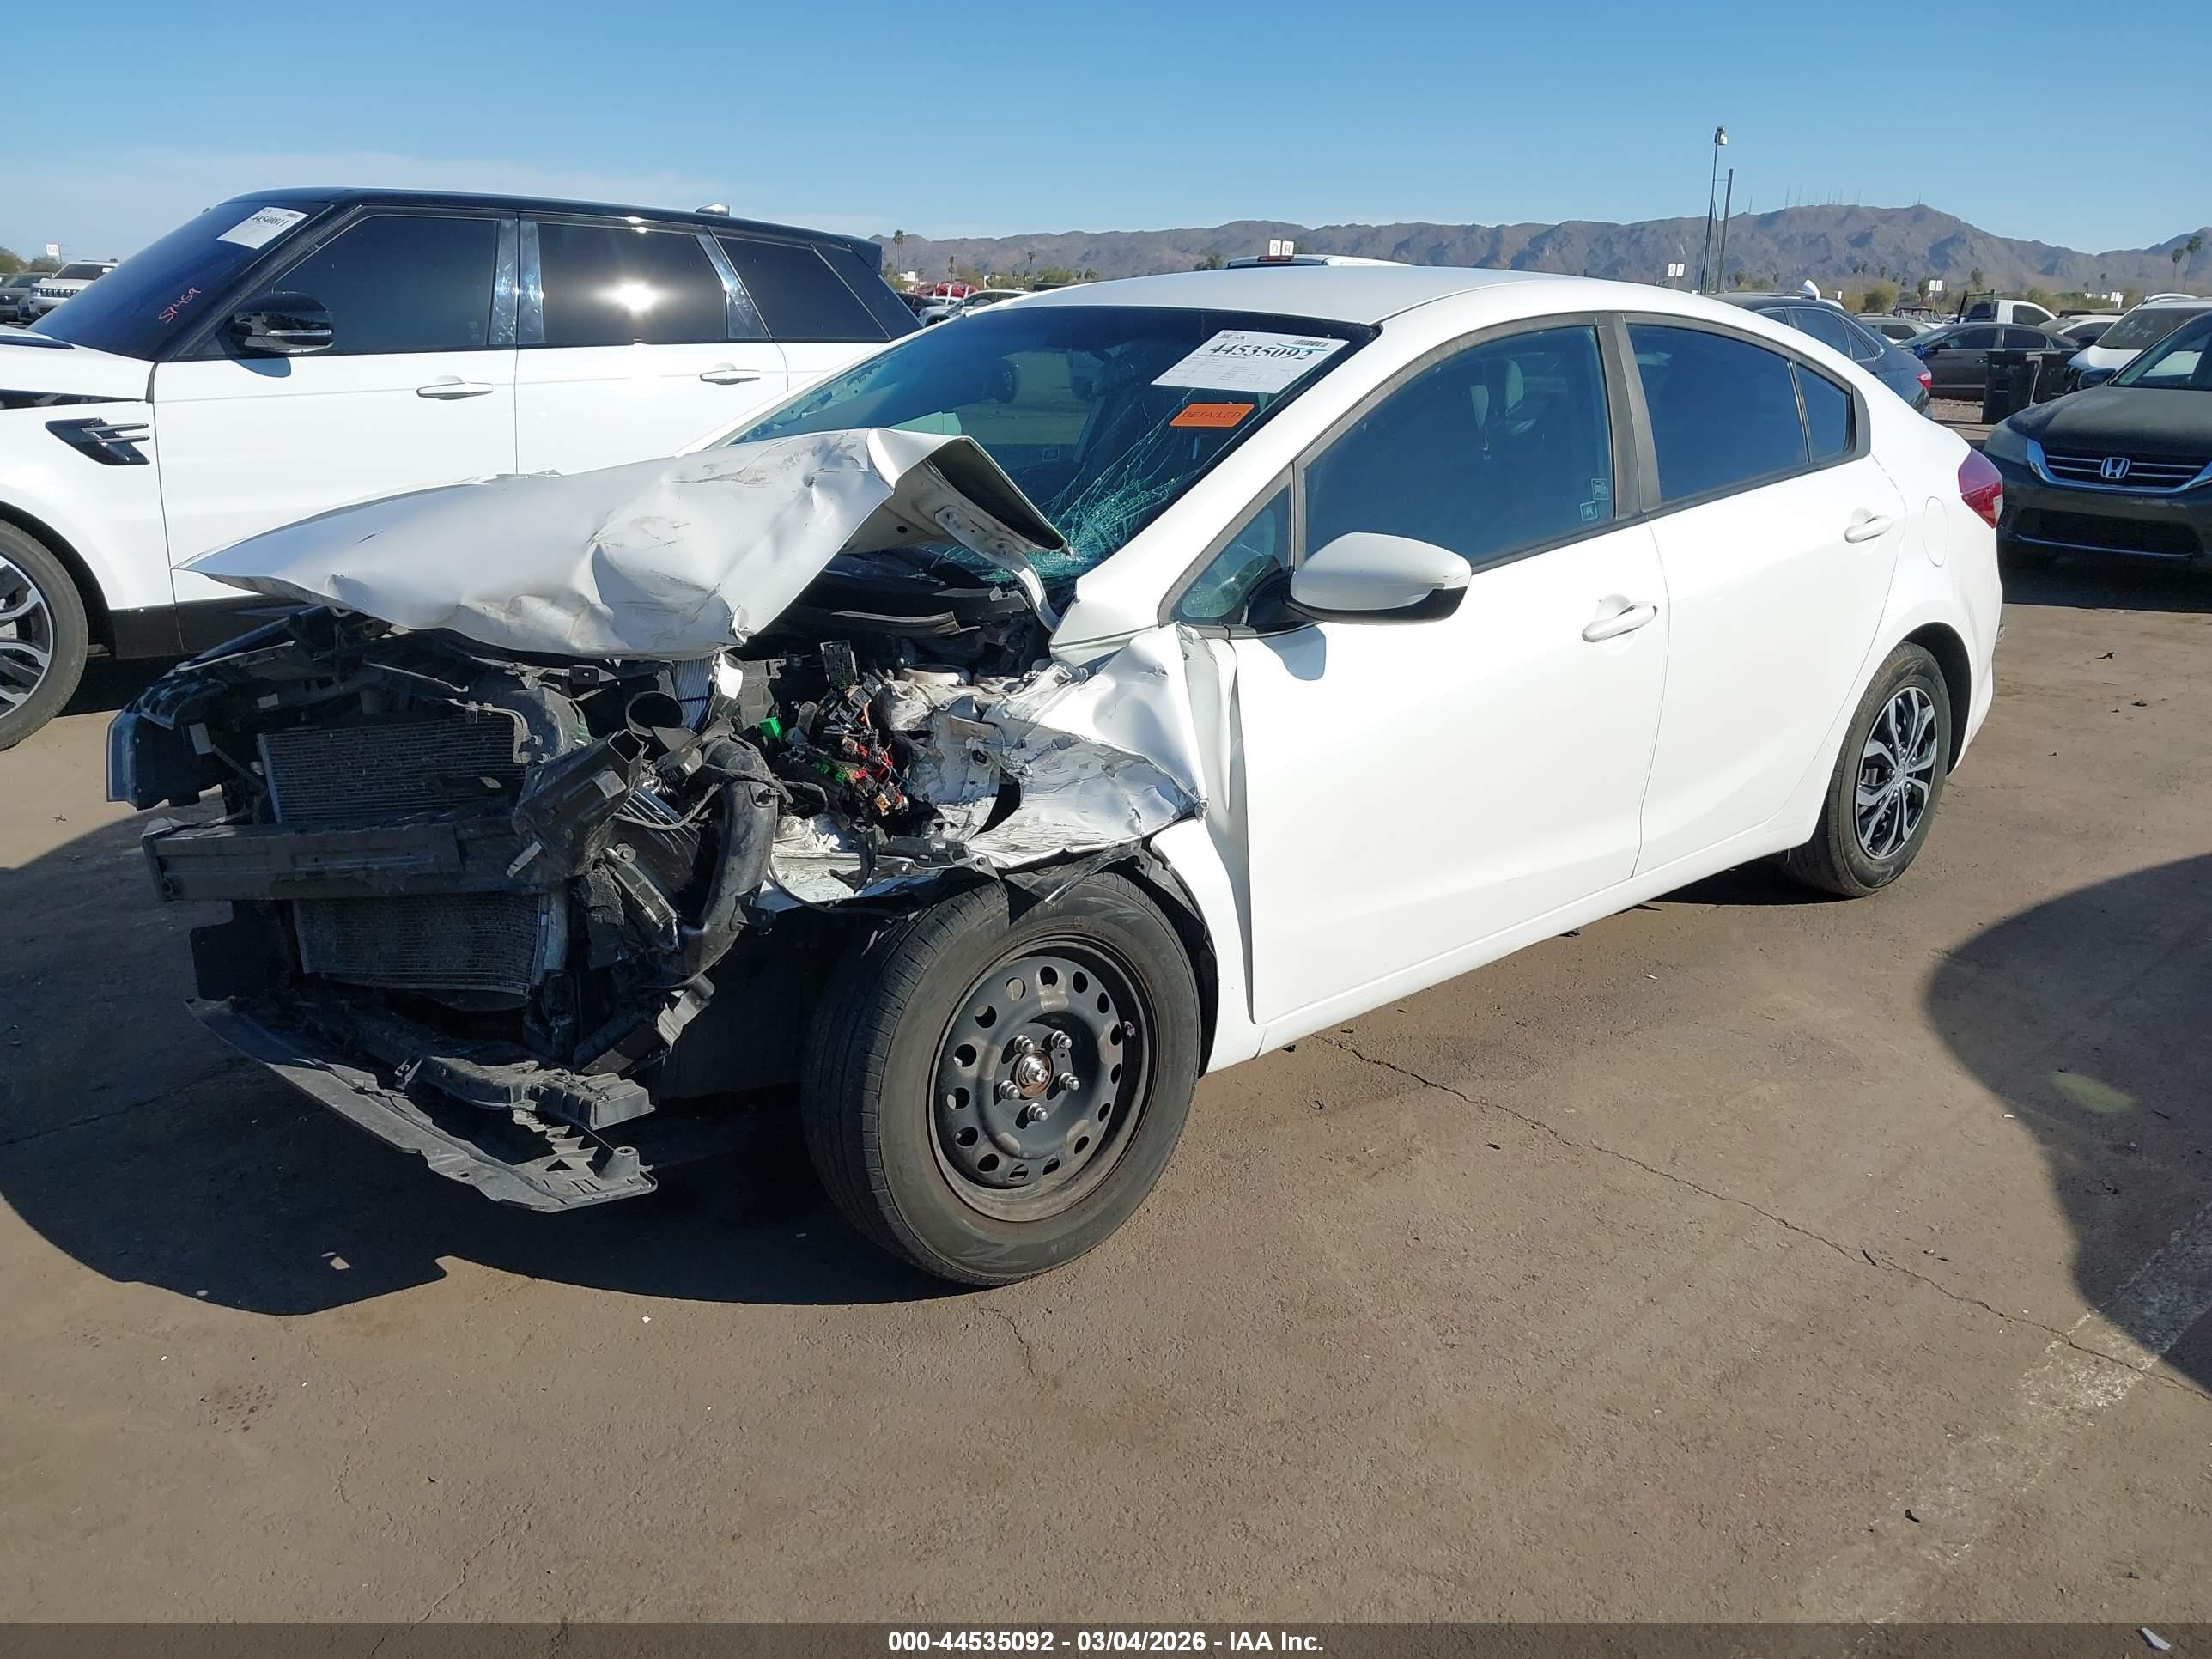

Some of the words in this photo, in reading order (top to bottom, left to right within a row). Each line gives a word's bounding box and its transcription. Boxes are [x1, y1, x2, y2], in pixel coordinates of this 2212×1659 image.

[1272, 243, 1279, 254] Q
[1285, 244, 1291, 255] R
[1209, 343, 1314, 360] 44535092
[1181, 411, 1242, 420] DETAILED
